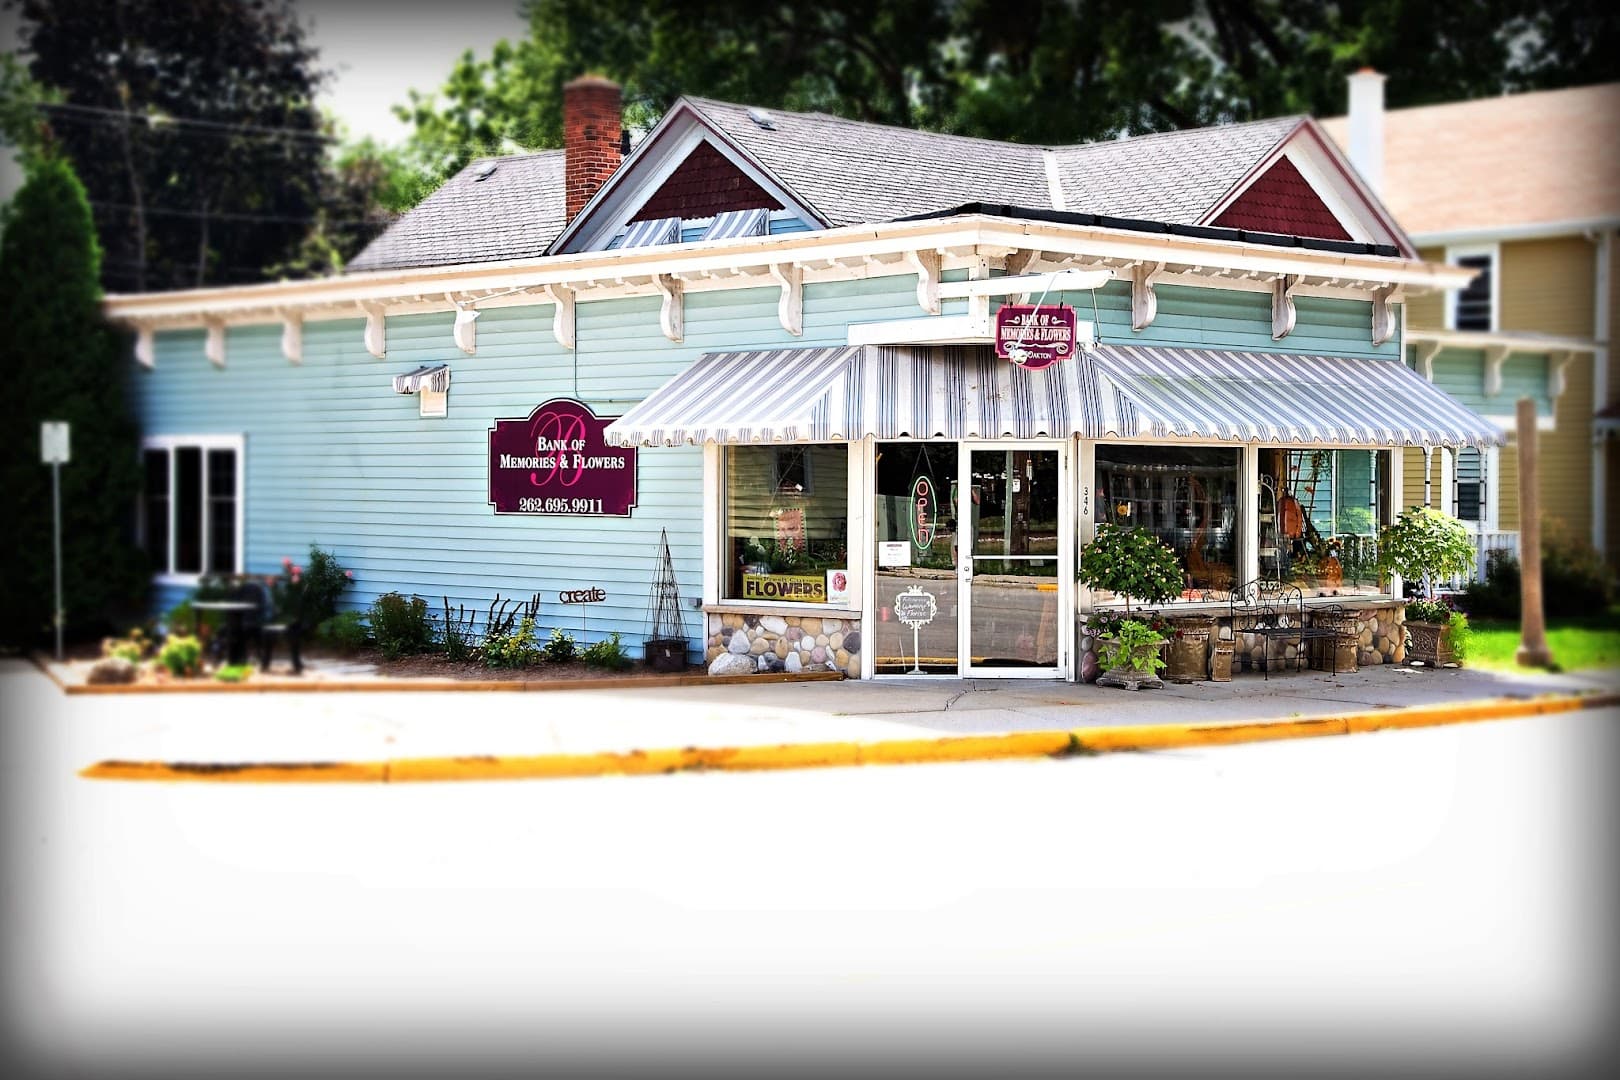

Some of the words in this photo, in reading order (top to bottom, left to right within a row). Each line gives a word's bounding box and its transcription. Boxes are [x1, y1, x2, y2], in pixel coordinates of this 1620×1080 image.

[1021, 314, 1039, 325] BANK
[1040, 314, 1049, 325] OF
[1000, 328, 1033, 340] MEMORIES
[1034, 329, 1040, 340] &
[1041, 329, 1071, 341] FLOWERS
[537, 436, 567, 451] BANK
[571, 439, 586, 451] OF
[500, 454, 556, 469] MEMORIES
[560, 454, 569, 469] &
[573, 454, 625, 469] FLOWERS
[519, 498, 604, 514] 262.695.9911
[916, 480, 929, 542] OPEN
[559, 586, 606, 603] create
[746, 581, 823, 598] FLOWERS
